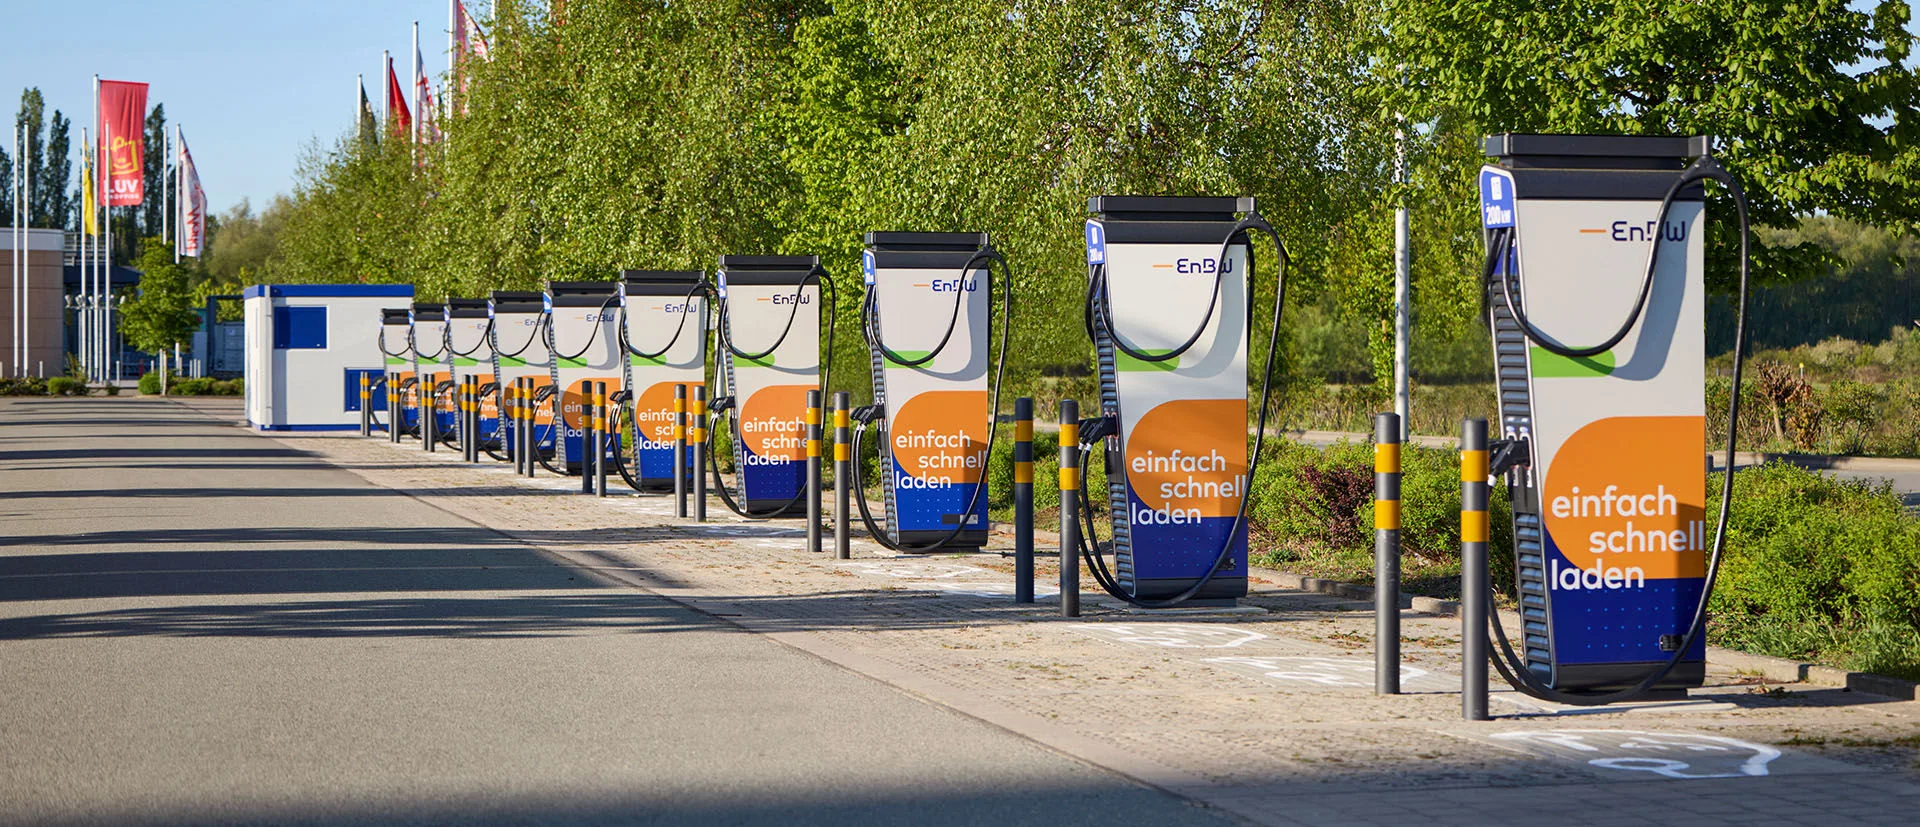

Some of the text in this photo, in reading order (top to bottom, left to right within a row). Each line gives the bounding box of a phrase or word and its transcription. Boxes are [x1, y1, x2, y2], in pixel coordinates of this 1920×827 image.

[1177, 258, 1232, 273] EnBW
[639, 408, 692, 422] einfa
[743, 416, 805, 432] einfach
[762, 434, 807, 449] schne
[895, 430, 971, 448] einfach
[743, 450, 790, 466] laden
[1131, 449, 1226, 473] einfach
[895, 471, 951, 489] laden
[1160, 475, 1246, 498] schnell
[1551, 485, 1676, 518] einfach
[1131, 502, 1201, 525] laden
[1589, 520, 1704, 553] schnell
[1551, 558, 1645, 590] laden
